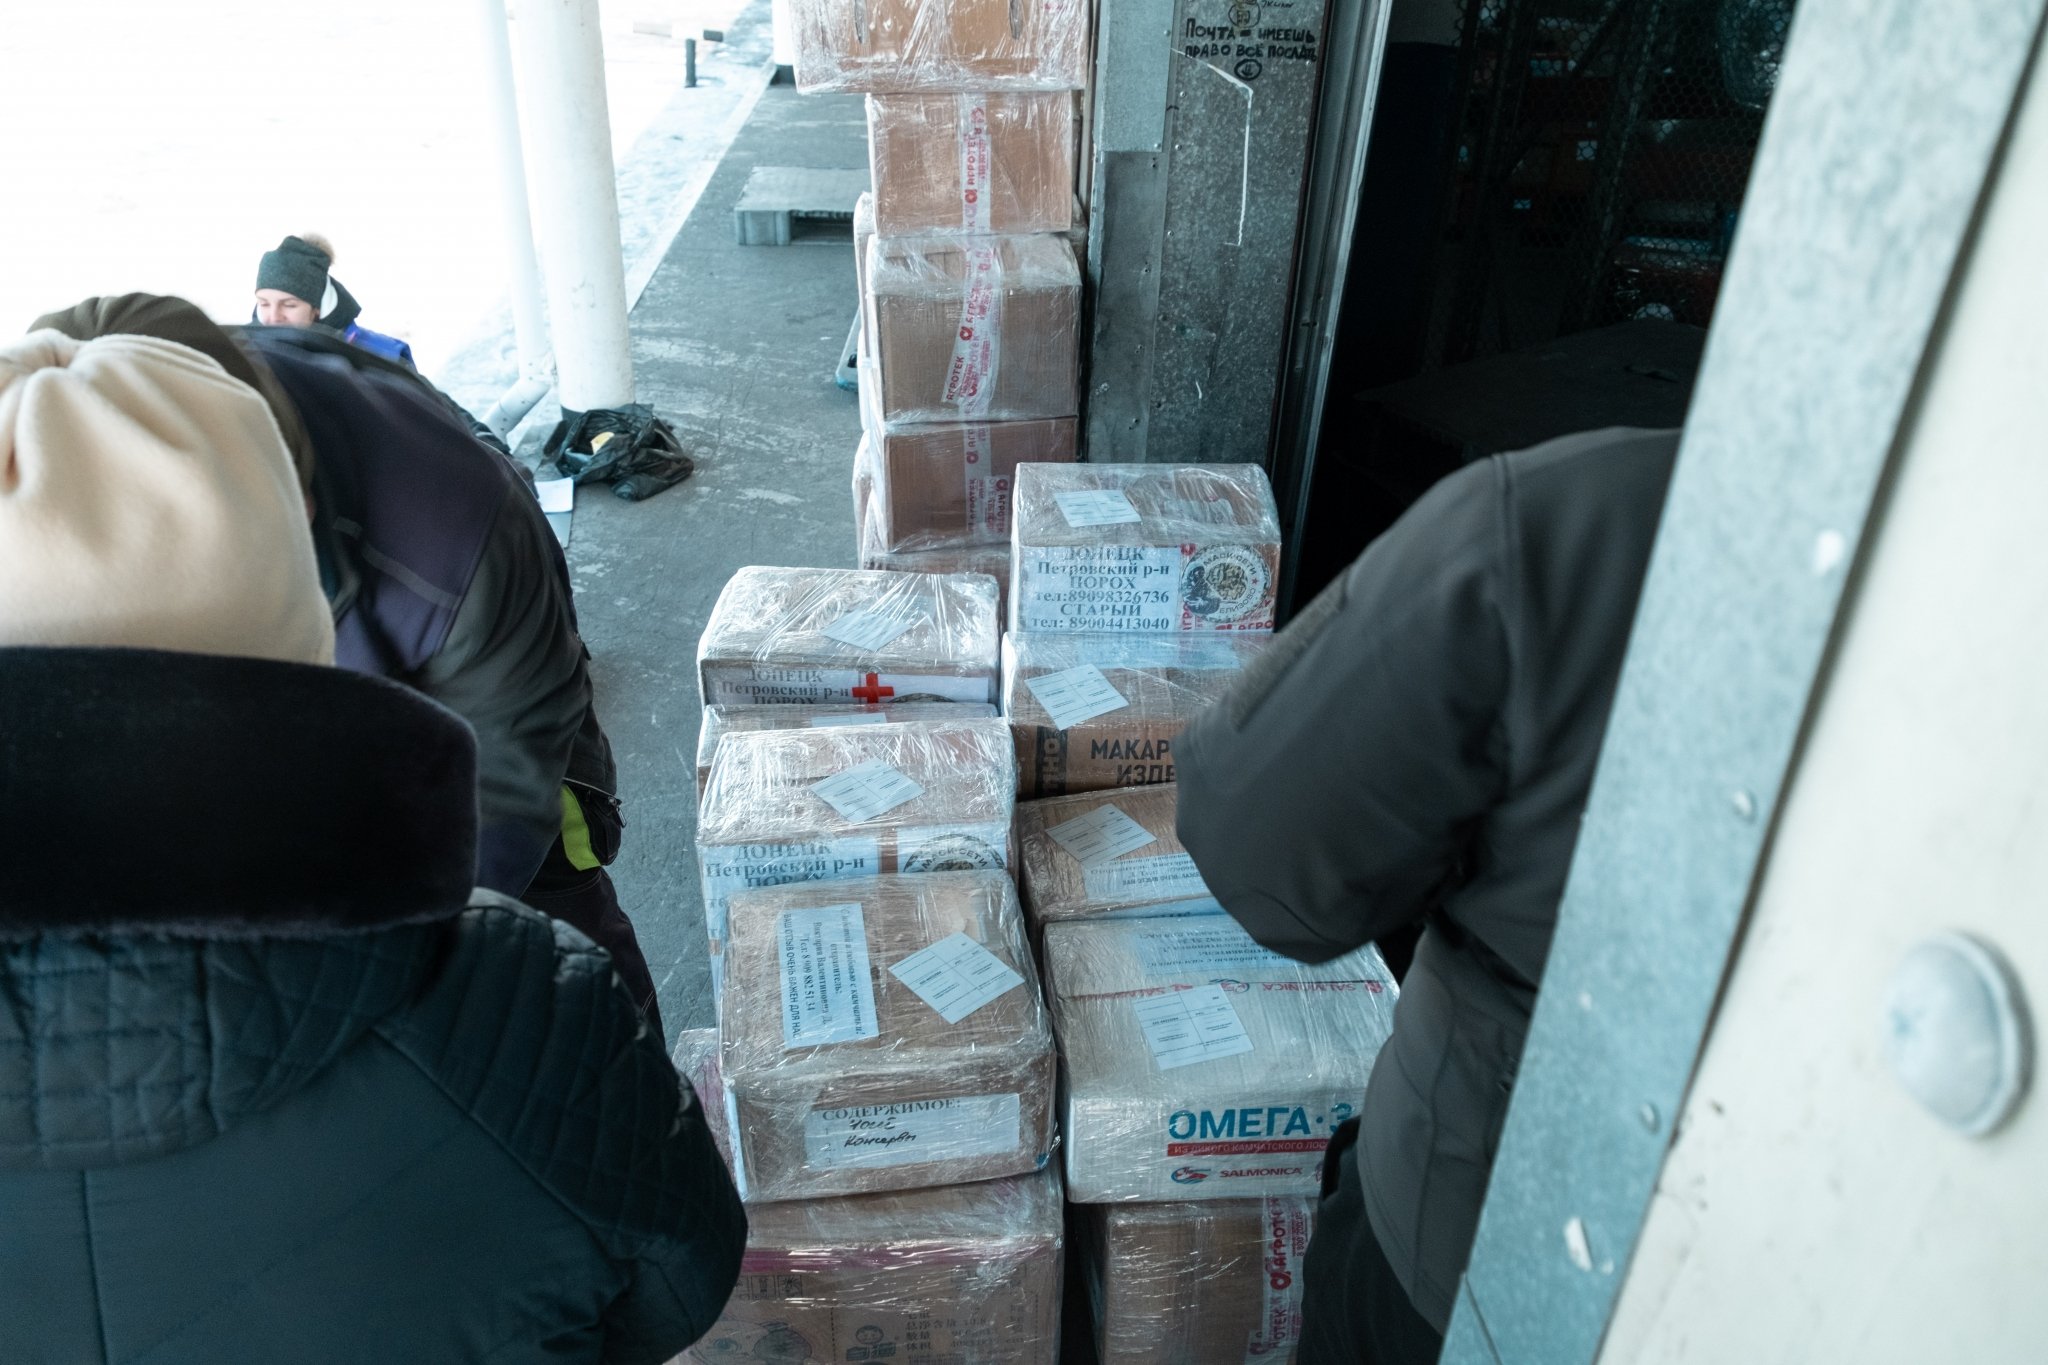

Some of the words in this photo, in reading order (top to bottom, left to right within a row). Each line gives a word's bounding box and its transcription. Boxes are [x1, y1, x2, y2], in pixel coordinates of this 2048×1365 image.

[1185, 43, 1231, 58] ПРАВО
[945, 355, 965, 402] АГРОТЕК
[997, 493, 1008, 535] АГРОТЕК
[1038, 561, 1138, 577] Петровский
[1143, 564, 1170, 578] р-н
[1070, 576, 1136, 589] ПОРОХ
[1060, 602, 1142, 616] СТАРЫЙ
[1031, 618, 1064, 629] тел:
[1069, 617, 1170, 630] 89004413040
[721, 682, 818, 699] Петровский
[823, 687, 850, 699] р-н
[706, 857, 827, 879] Петровский
[833, 858, 865, 874] р-н
[787, 952, 797, 976] ОЧЕНЬ
[788, 977, 799, 1003] ВАЖЕН
[789, 1004, 800, 1020] ДЛЯ
[822, 1098, 962, 1121] СОДЕРЖИМОЕ:
[1231, 1140, 1304, 1152] КАМЧАТСКОГО
[1220, 1166, 1303, 1178] SALMONICA
